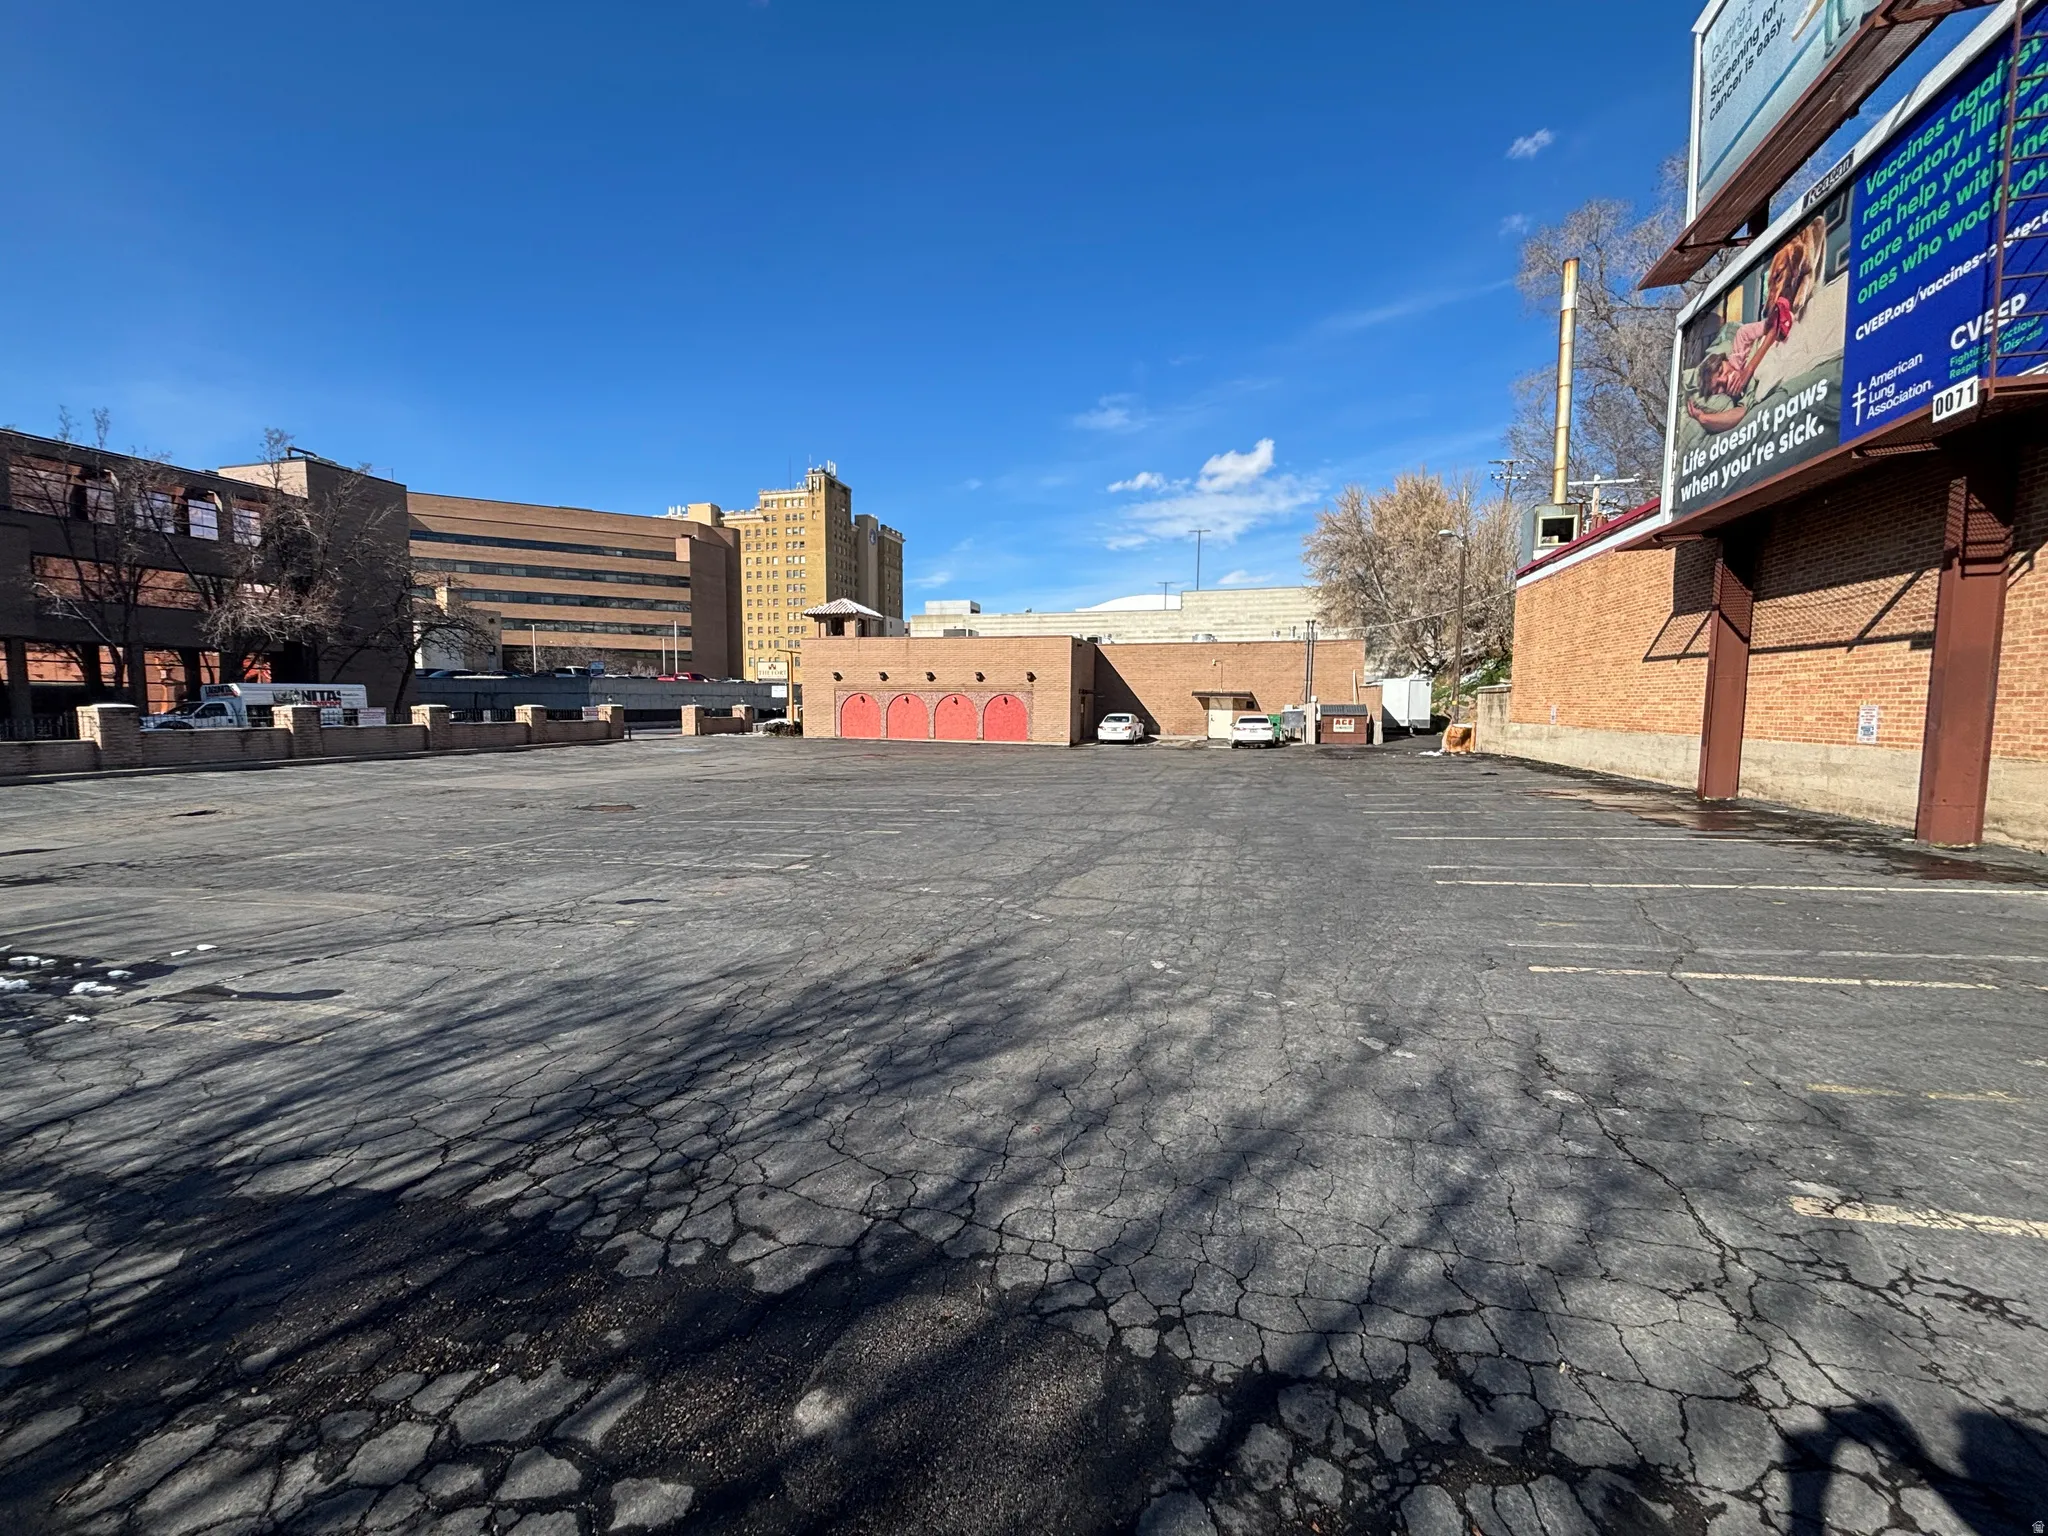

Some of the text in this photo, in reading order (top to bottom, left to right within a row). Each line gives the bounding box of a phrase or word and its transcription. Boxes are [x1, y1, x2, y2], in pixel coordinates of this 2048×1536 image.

[1761, 0, 1777, 29] for
[1709, 12, 1787, 121] cancer is easy.
[1862, 127, 1966, 226] respiratory
[1866, 117, 1946, 196] Vaccines
[1858, 235, 1904, 279] more
[1906, 200, 1951, 243] time
[1956, 158, 2006, 206] with
[1860, 216, 1893, 251] can
[1896, 181, 1938, 225] help
[1942, 145, 1982, 194] you
[1857, 265, 1899, 304] ones
[1901, 235, 1943, 274] who
[1950, 293, 2028, 350] CVEEP
[1868, 353, 1923, 390] American
[1868, 382, 1896, 405] Lung
[1935, 381, 1976, 417] 0071
[1680, 412, 1825, 503] when you're sick.
[1682, 378, 1828, 478] Life doesn't paws
